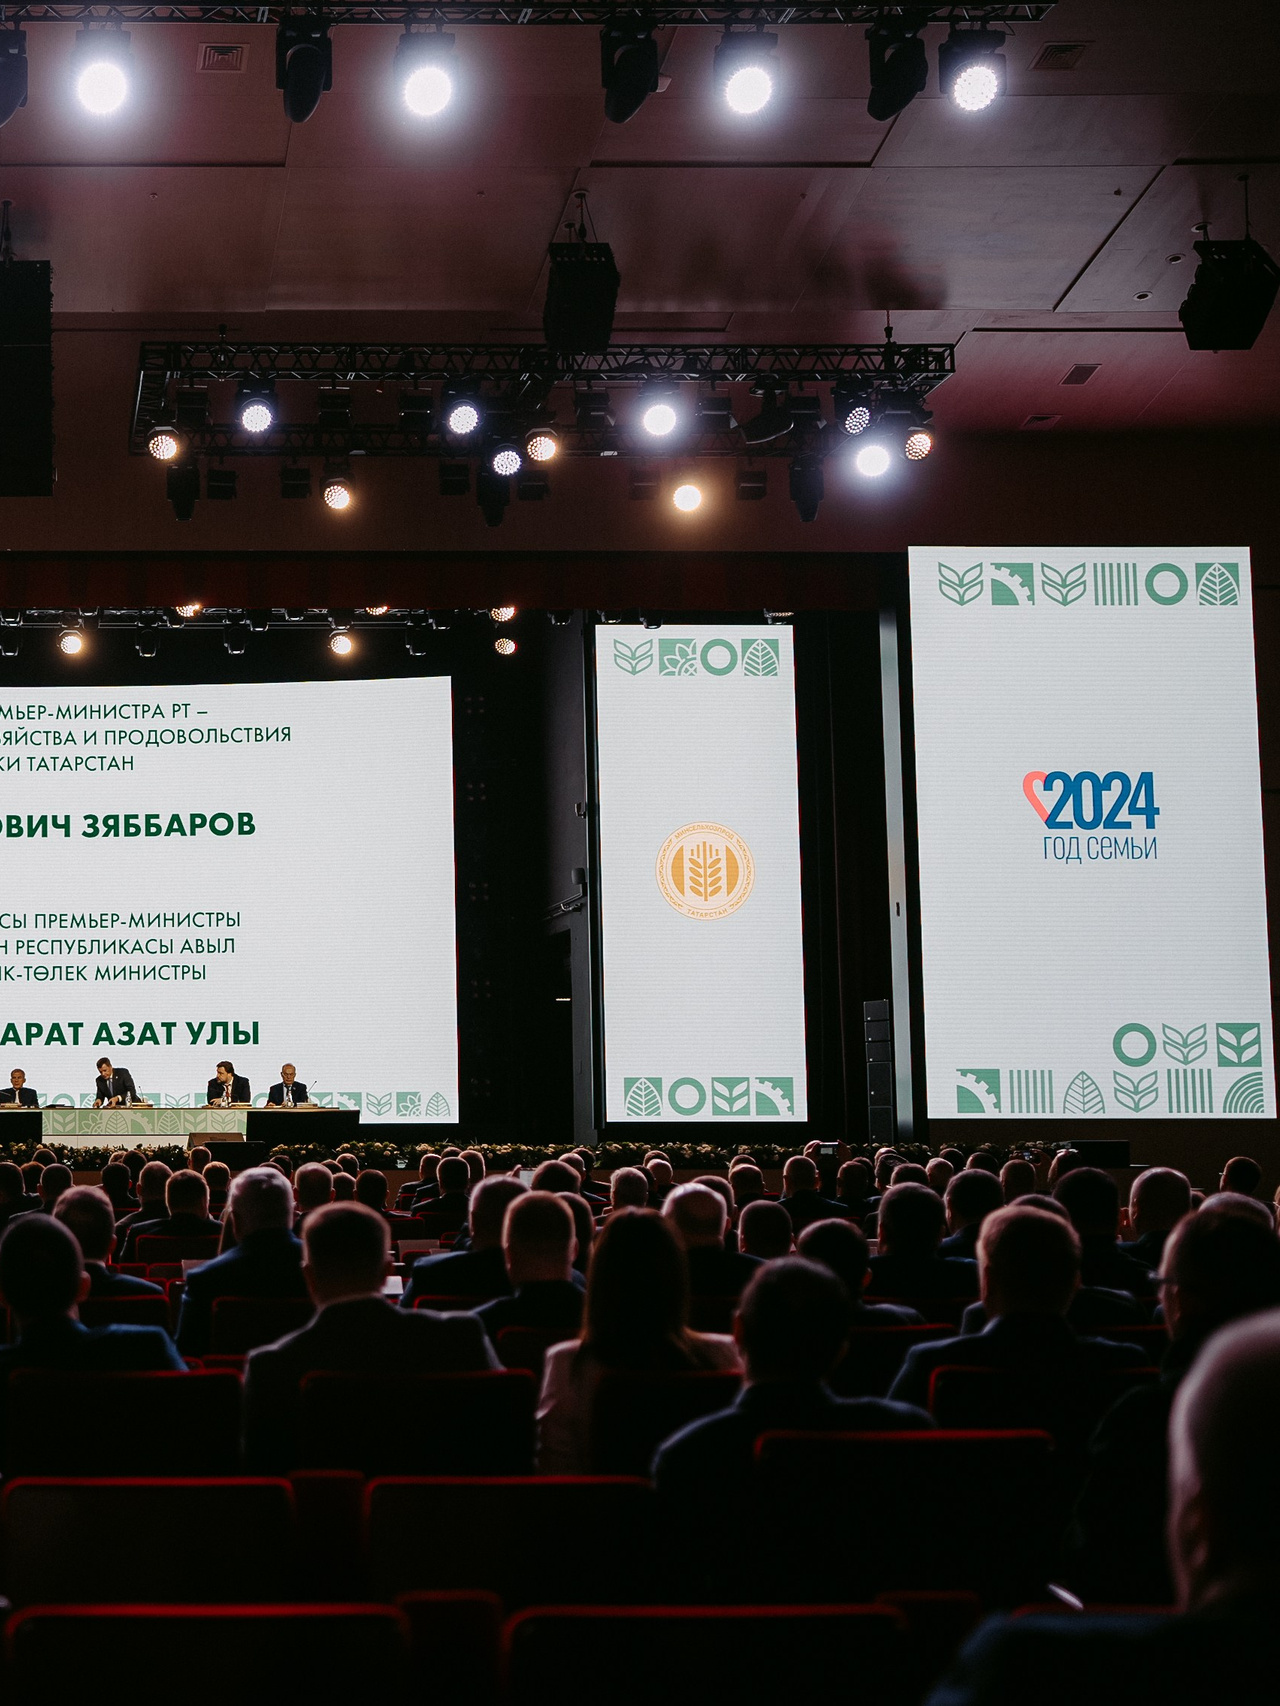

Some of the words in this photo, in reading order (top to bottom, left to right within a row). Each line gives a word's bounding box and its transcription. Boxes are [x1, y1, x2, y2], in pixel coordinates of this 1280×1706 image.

[171, 702, 192, 719] РТ
[83, 729, 98, 746] И
[104, 727, 291, 748] ПРОДОВОЛЬСТВИЯ
[26, 755, 134, 772] ТАТАРСТАН
[1043, 771, 1160, 830] 2024
[80, 811, 256, 839] ЗЯББАРОВ
[675, 825, 734, 840] МИНСЕЛЬХОЗПРОД
[34, 911, 241, 929] ПРЕМЬЕР-МИНИСТРЫ
[686, 908, 728, 918] ТАТАРСТАН
[15, 938, 174, 956] РЕСПУБЛИКАСЫ
[179, 937, 235, 955] АВЫЛ
[94, 964, 206, 982] МИНИСТРЫ
[91, 1021, 178, 1047] АЗАТ
[184, 1020, 260, 1046] УЛЫ
